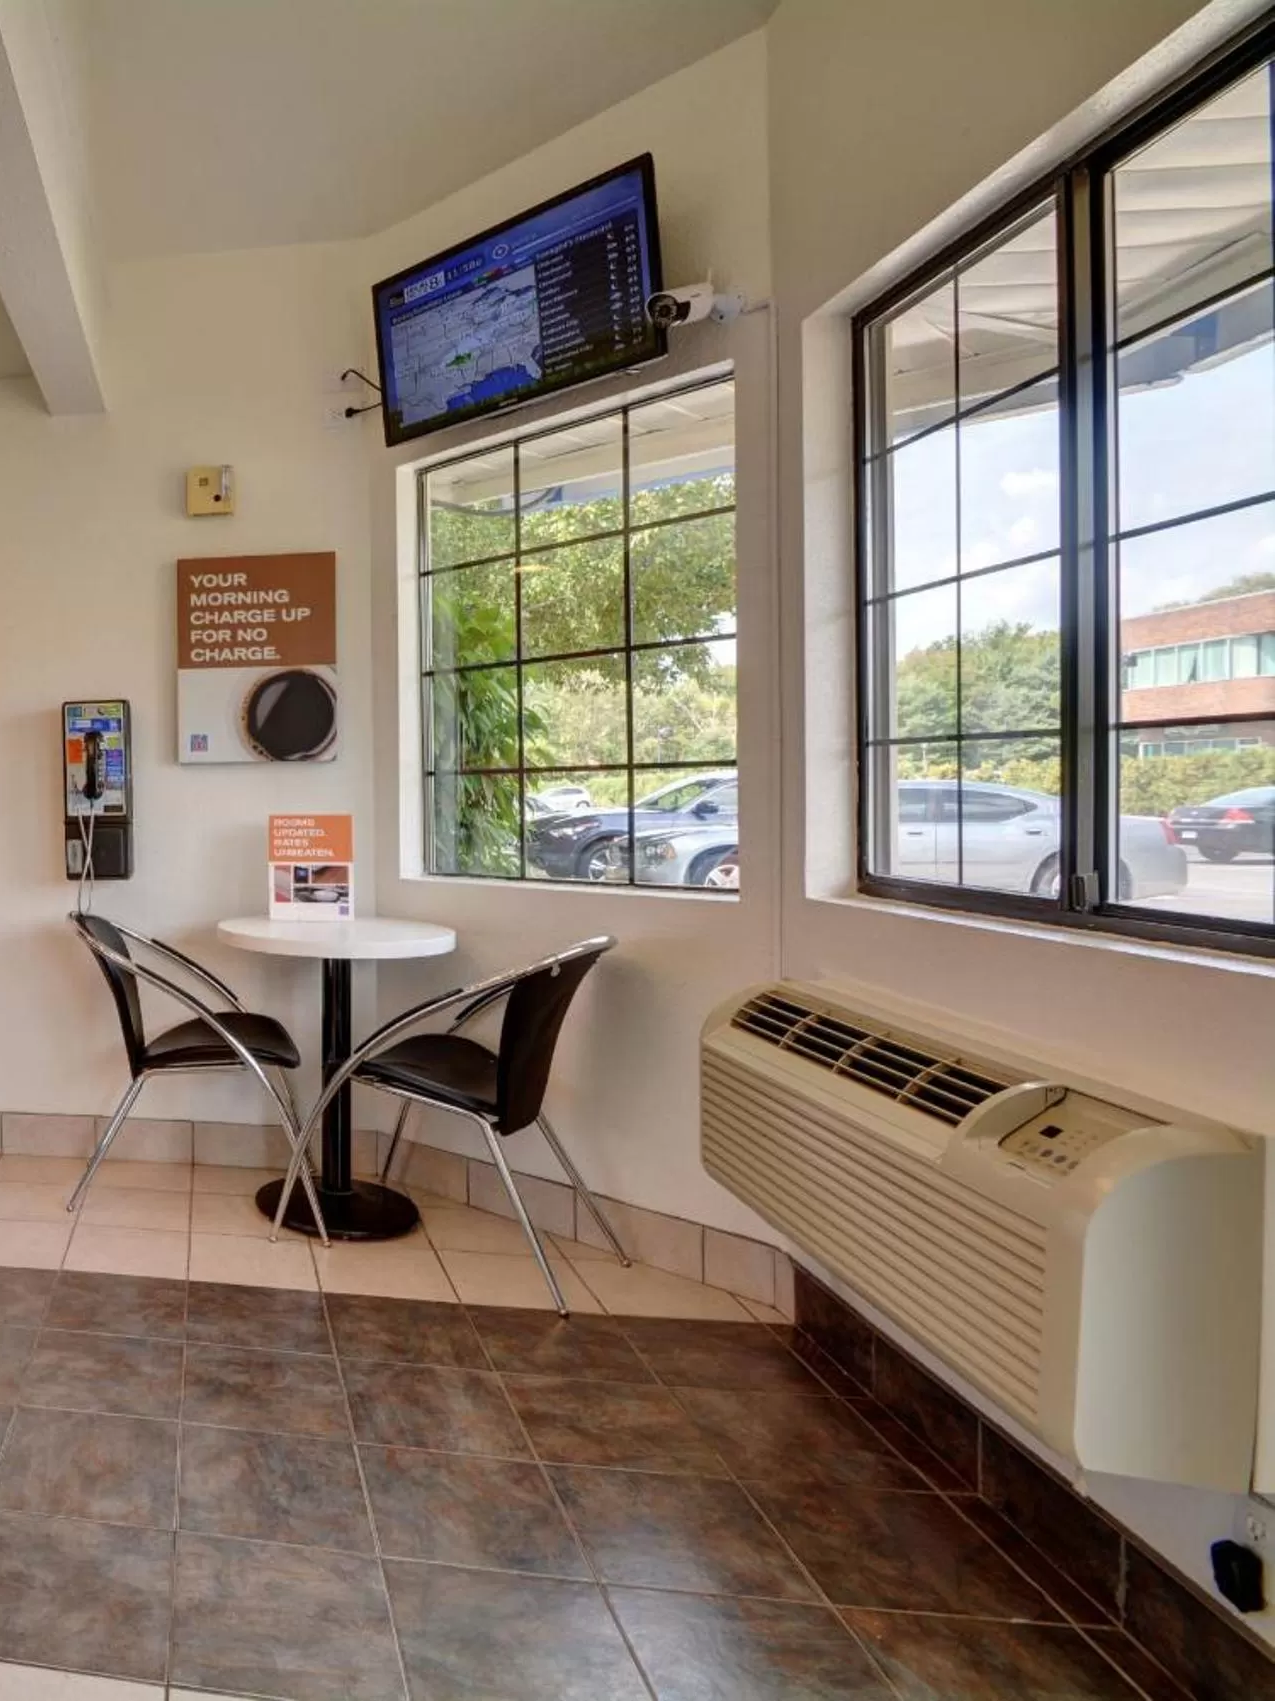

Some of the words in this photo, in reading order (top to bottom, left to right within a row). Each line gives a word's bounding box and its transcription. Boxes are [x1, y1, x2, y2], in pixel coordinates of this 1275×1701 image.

[190, 572, 248, 588] YOUR
[190, 589, 290, 606] MORNING
[190, 609, 276, 625] CHARGE
[281, 607, 311, 622] UP
[190, 629, 232, 644] FOR
[237, 628, 268, 642] NO
[190, 646, 282, 662] CHARGE.
